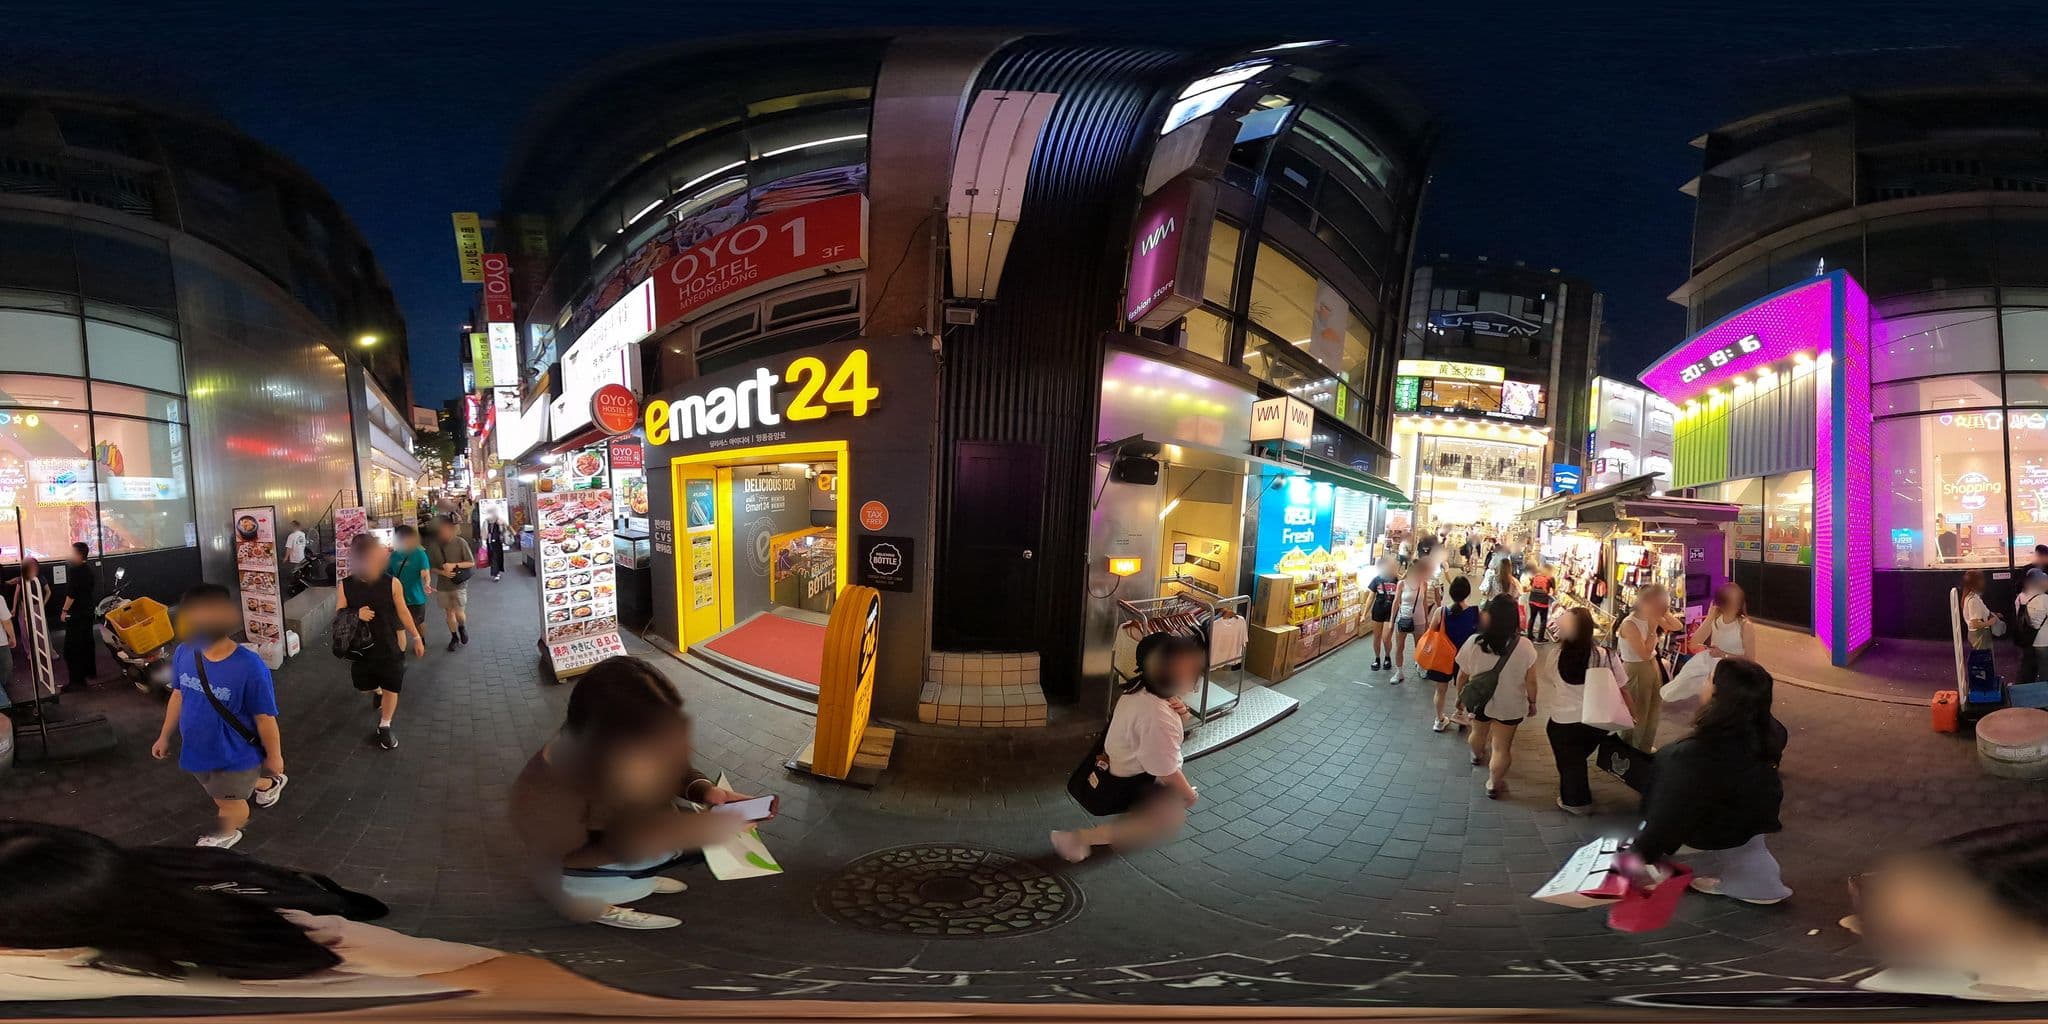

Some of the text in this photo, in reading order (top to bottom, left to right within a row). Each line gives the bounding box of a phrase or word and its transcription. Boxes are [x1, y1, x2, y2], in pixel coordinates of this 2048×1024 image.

[671, 217, 806, 285] OYO 1
[822, 245, 845, 259] 3F
[484, 259, 506, 295] OYO
[679, 256, 757, 300] HOSTEL
[680, 269, 758, 310] MYEONGDONG
[1128, 280, 1174, 320] fashion store
[600, 394, 626, 407] OYO
[645, 349, 880, 446] emart 24
[602, 406, 626, 414] HOSTEL
[1257, 405, 1279, 422] WM
[1292, 405, 1309, 428] WM
[612, 447, 632, 456] OYO
[744, 478, 797, 493] DELICIOUS IDEA
[1943, 480, 2001, 496] Shopping
[866, 510, 883, 518] TAX
[655, 531, 672, 542] CVS
[873, 556, 898, 565] BOTTLE
[808, 567, 836, 598] BOTTLE
